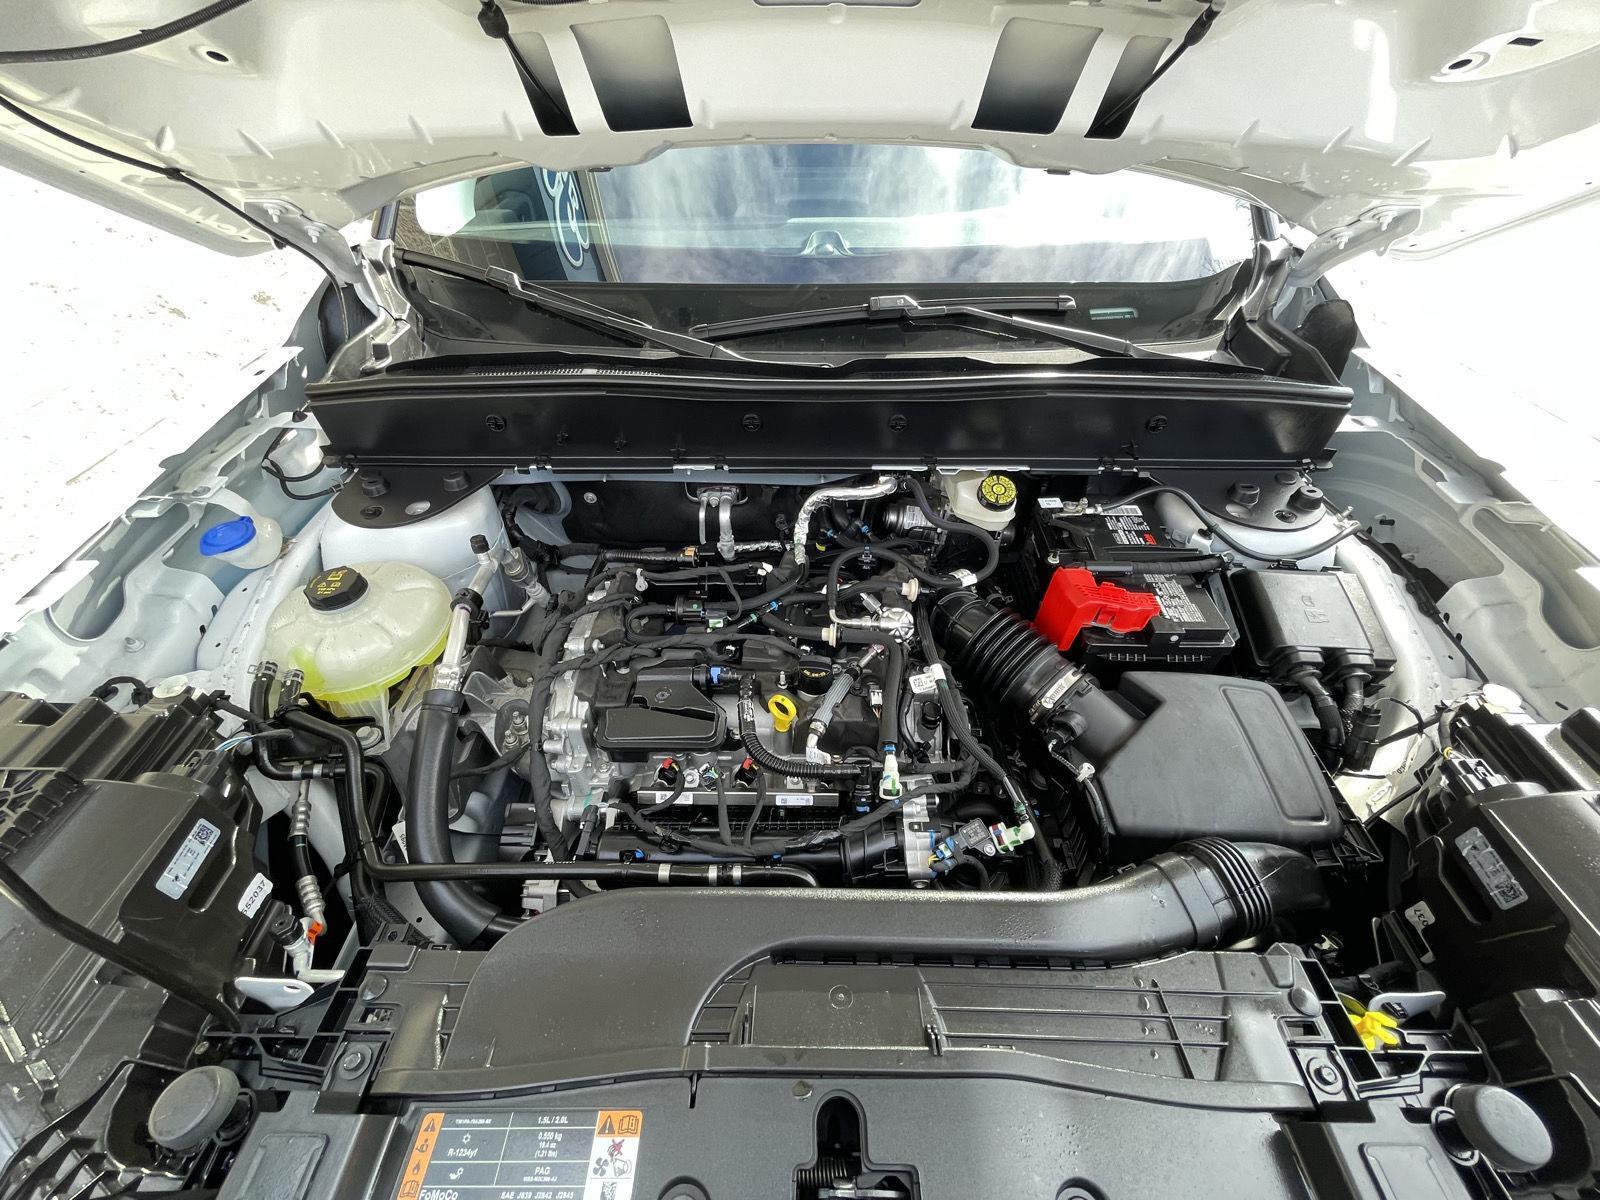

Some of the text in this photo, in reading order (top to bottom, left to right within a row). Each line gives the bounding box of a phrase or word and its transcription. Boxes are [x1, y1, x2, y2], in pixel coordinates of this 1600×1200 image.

[555, 1116, 568, 1124] 2.0L
[447, 1148, 478, 1158] R-1234yf
[534, 1166, 551, 1175] PAG
[418, 1189, 459, 1200] FoMoCo
